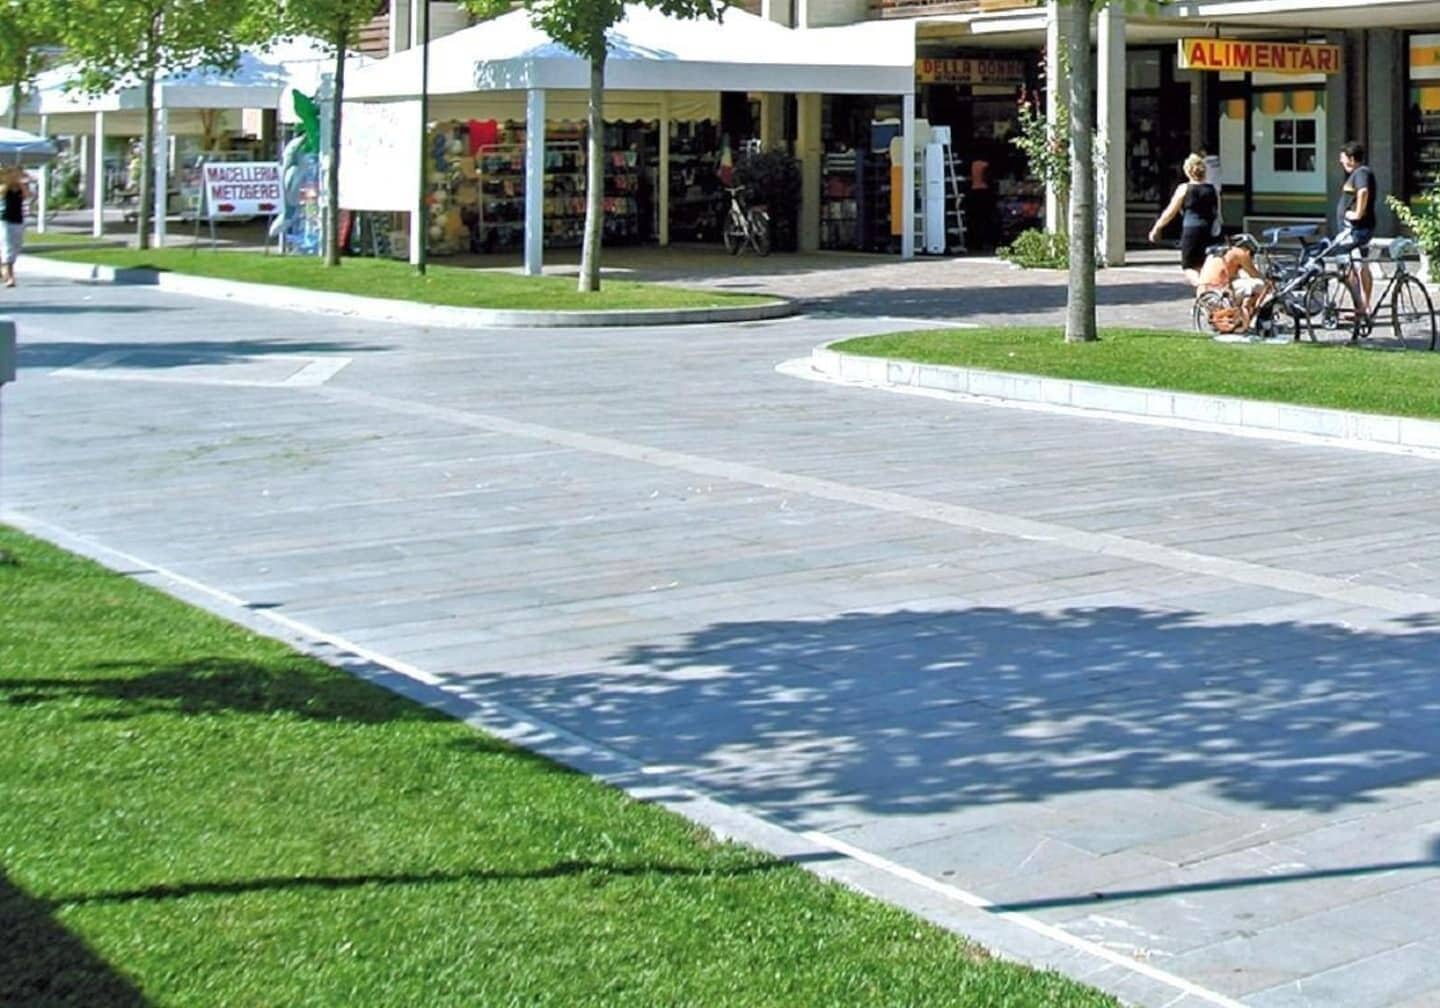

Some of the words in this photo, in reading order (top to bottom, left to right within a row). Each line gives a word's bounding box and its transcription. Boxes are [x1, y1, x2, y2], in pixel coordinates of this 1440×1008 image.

[1189, 42, 1339, 71] ALIMENTARI
[922, 59, 971, 75] DELLA
[207, 167, 279, 182] MACELLERIA
[211, 183, 280, 200] METZGEREI
